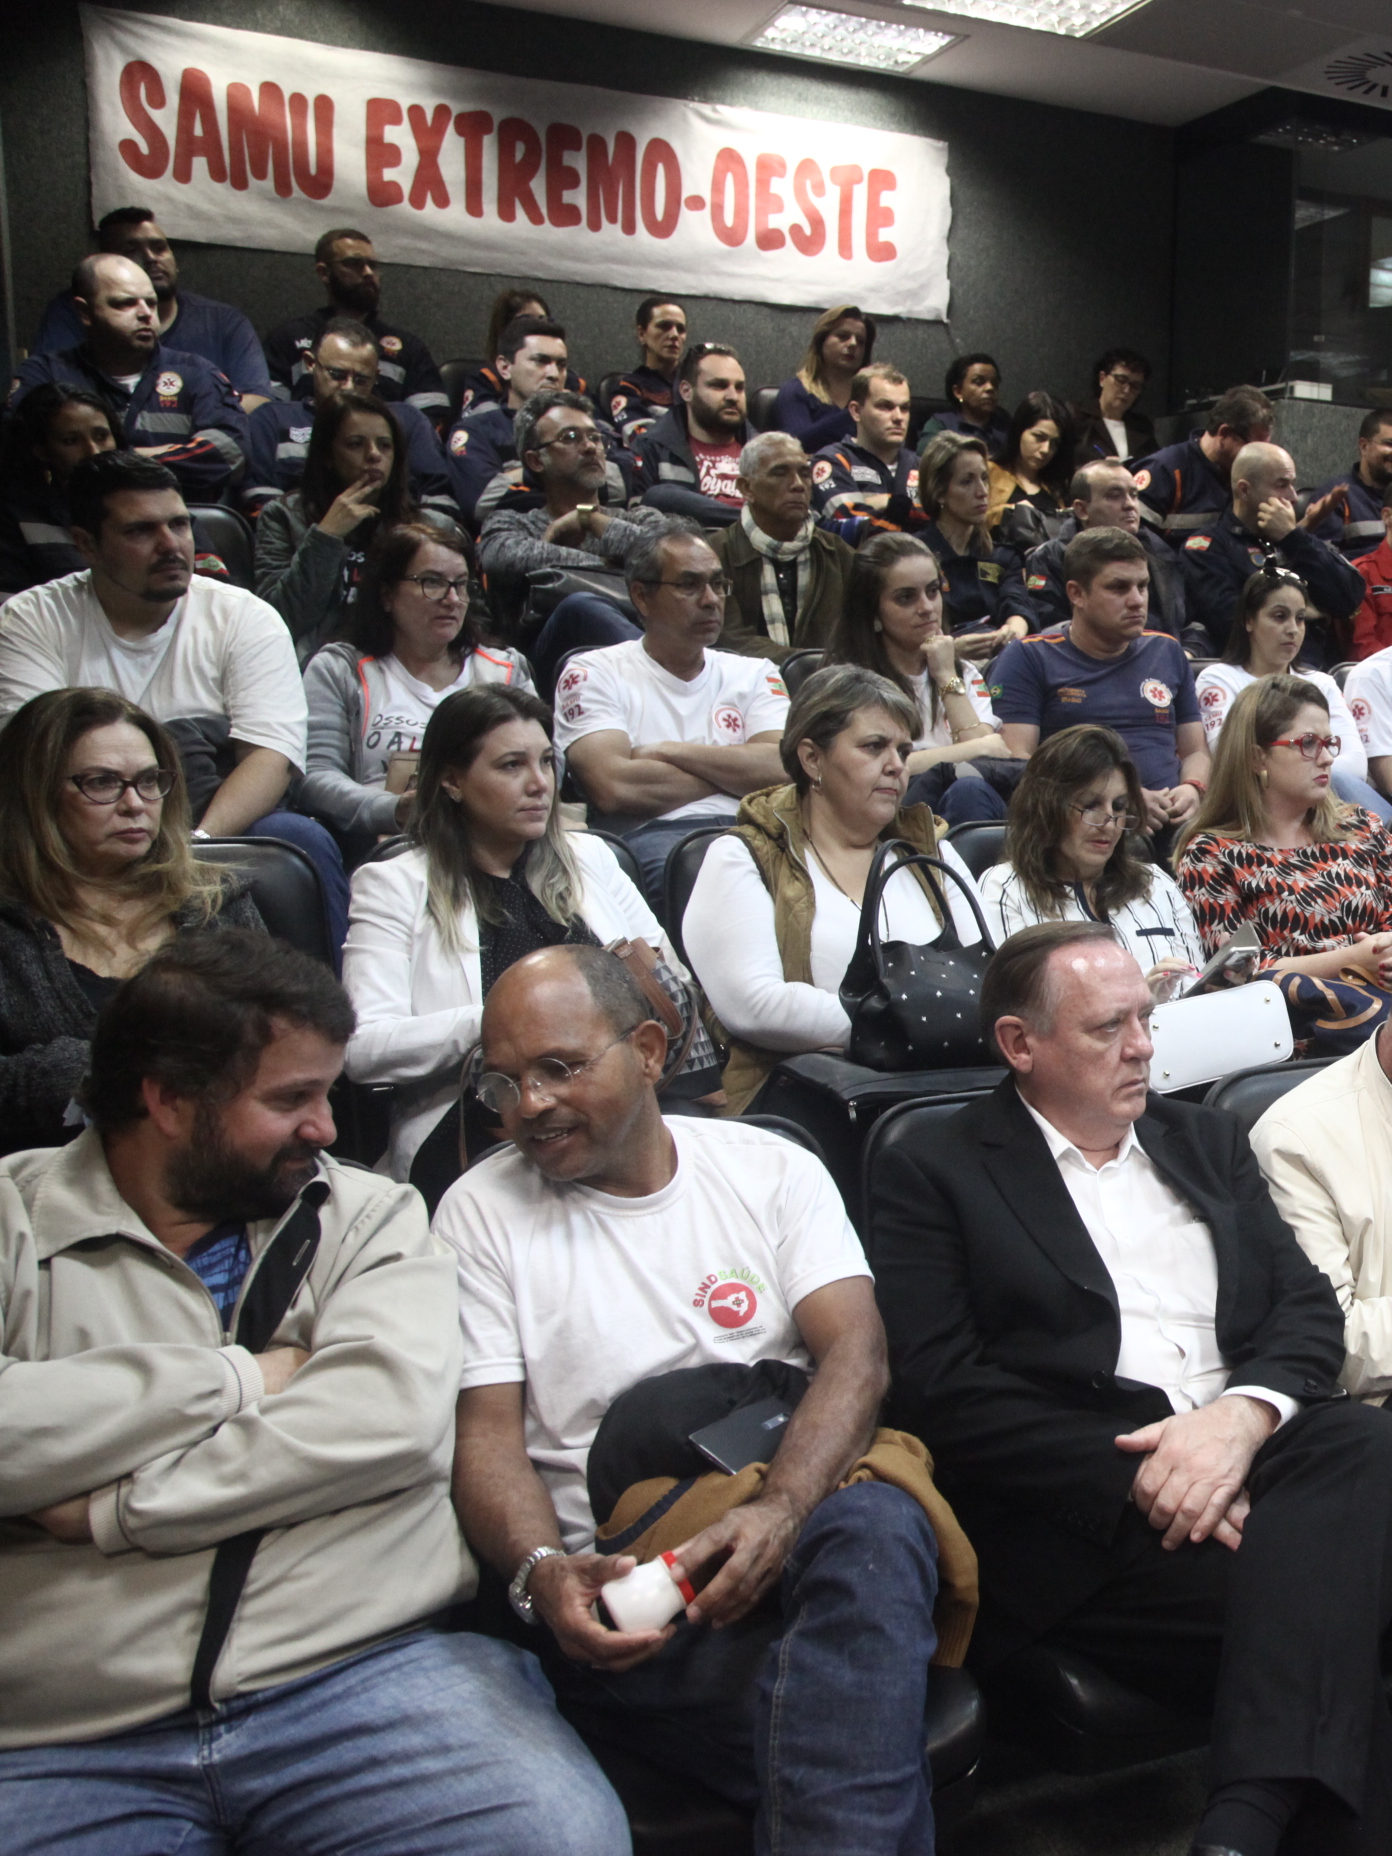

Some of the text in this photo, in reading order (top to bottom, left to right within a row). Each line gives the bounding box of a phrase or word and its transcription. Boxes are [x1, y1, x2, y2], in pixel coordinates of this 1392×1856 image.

[119, 60, 898, 262] SAMU EXTREMO-OESTE
[563, 703, 585, 723] 192
[1205, 718, 1223, 731] 192
[386, 731, 403, 751] A
